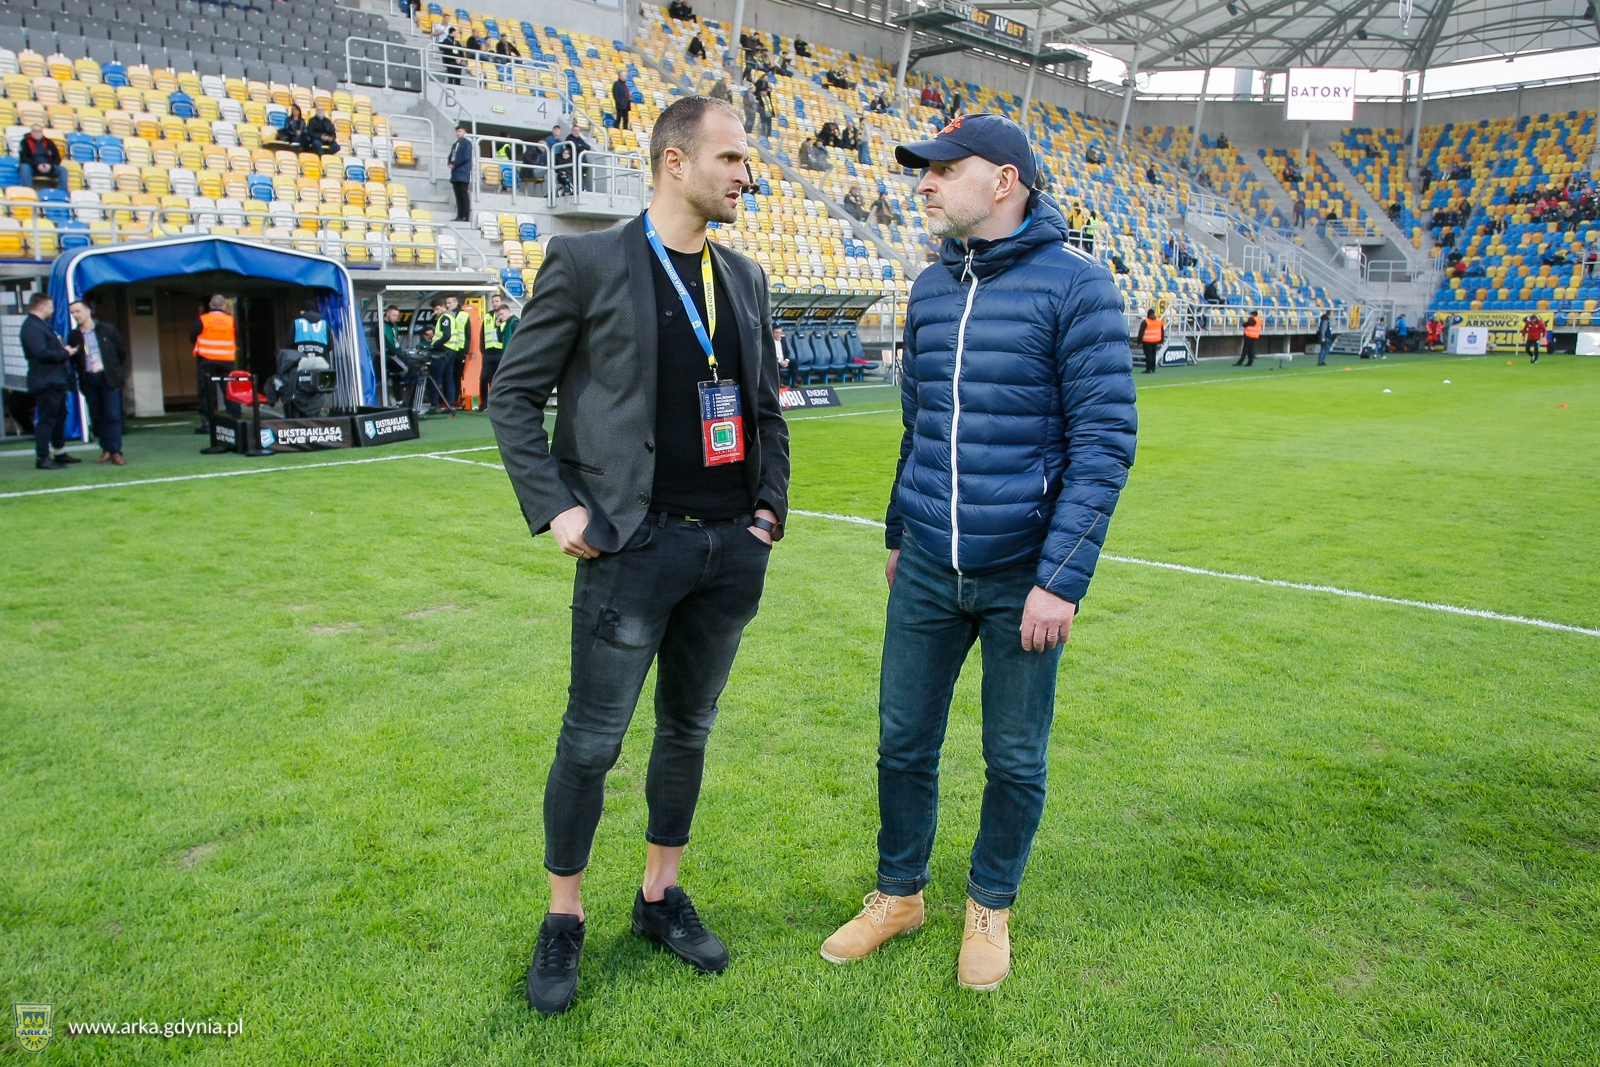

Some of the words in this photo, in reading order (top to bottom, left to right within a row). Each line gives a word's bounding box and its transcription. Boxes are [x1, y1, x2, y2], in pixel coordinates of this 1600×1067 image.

[994, 16, 1025, 37] LVBET
[1291, 86, 1352, 97] BATORY
[537, 101, 548, 119] 4
[674, 279, 687, 295] ARKA
[706, 281, 714, 303] GDYNIA
[772, 308, 803, 317] LVBET
[804, 308, 834, 317] LVBET
[835, 308, 863, 317] LVBET
[299, 319, 322, 333] TV
[806, 389, 829, 397] ENERGY
[810, 397, 830, 405] DRINK
[375, 416, 409, 428] EKSTRAKLASA
[278, 426, 342, 437] EKSTRAKLASA
[377, 427, 392, 435] LIVE
[393, 423, 411, 433] PARK
[309, 435, 343, 443] PARK
